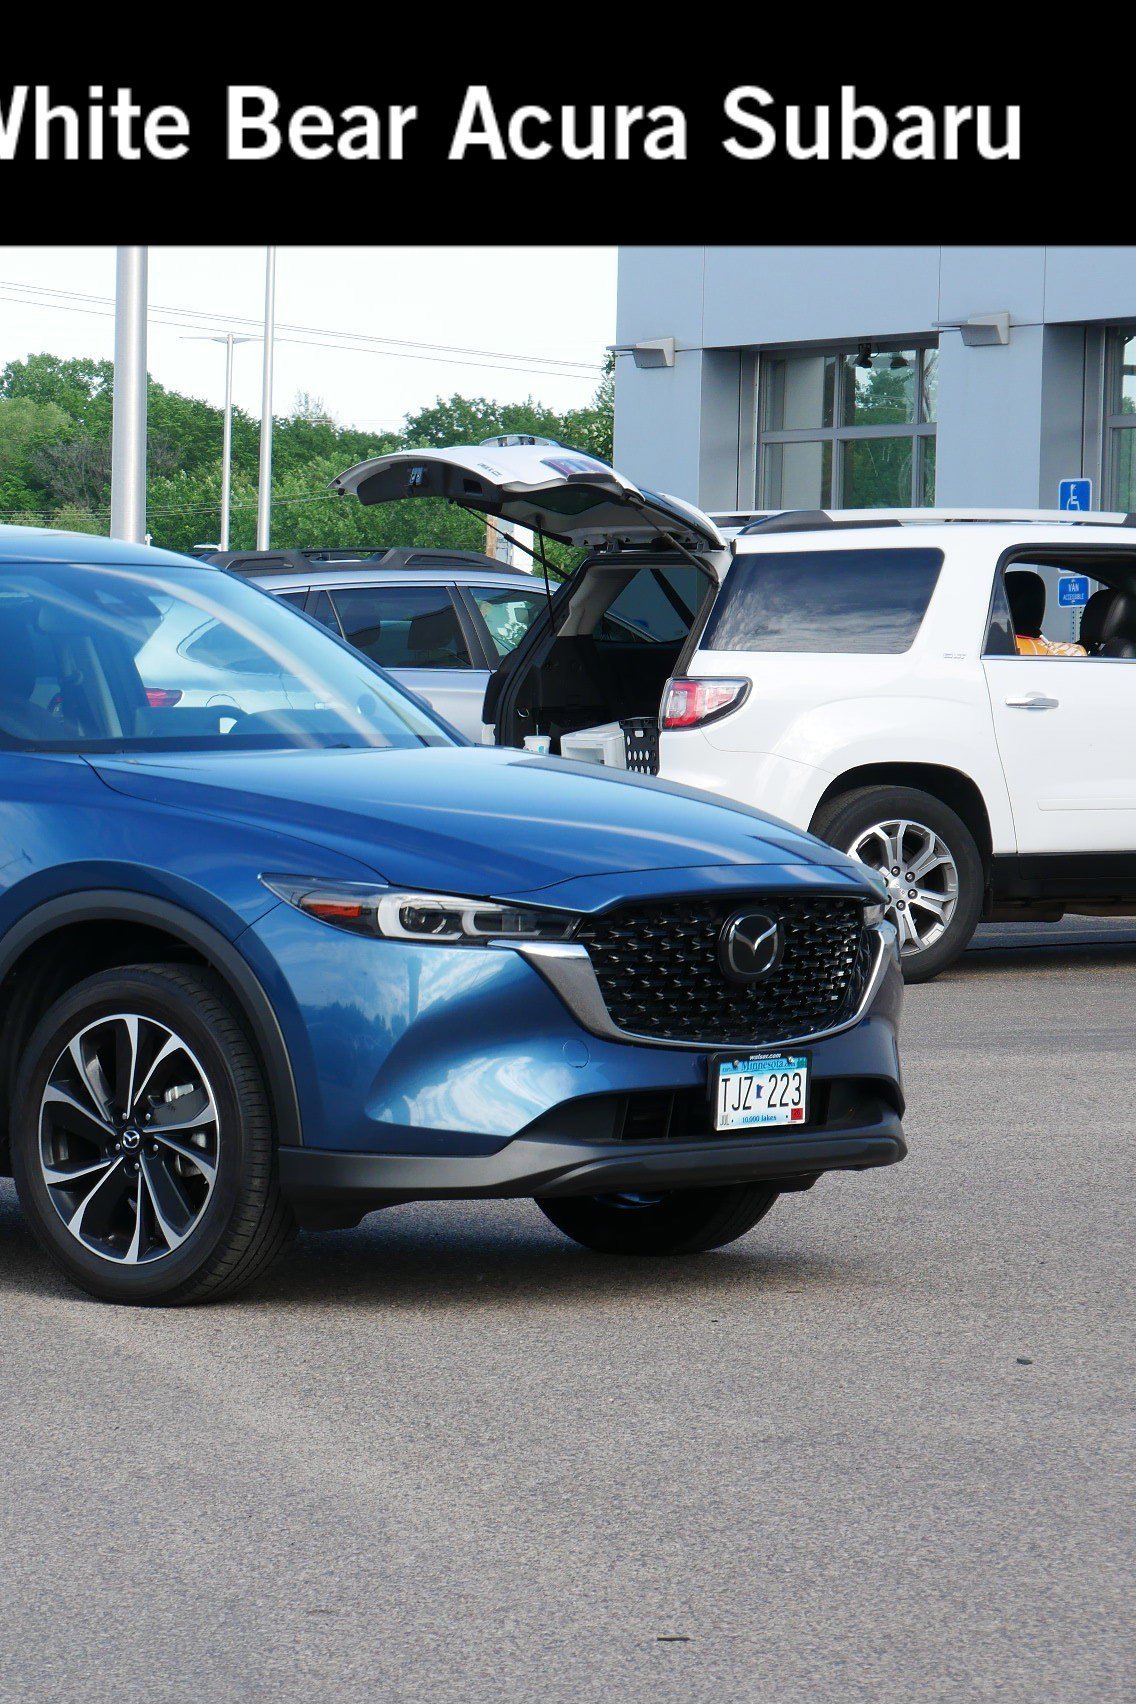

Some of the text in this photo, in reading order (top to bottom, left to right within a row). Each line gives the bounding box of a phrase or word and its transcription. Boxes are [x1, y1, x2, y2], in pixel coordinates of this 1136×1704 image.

[1068, 583, 1079, 592] VAN
[721, 1072, 802, 1112] TJZ 223
[761, 1114, 777, 1122] lakes
